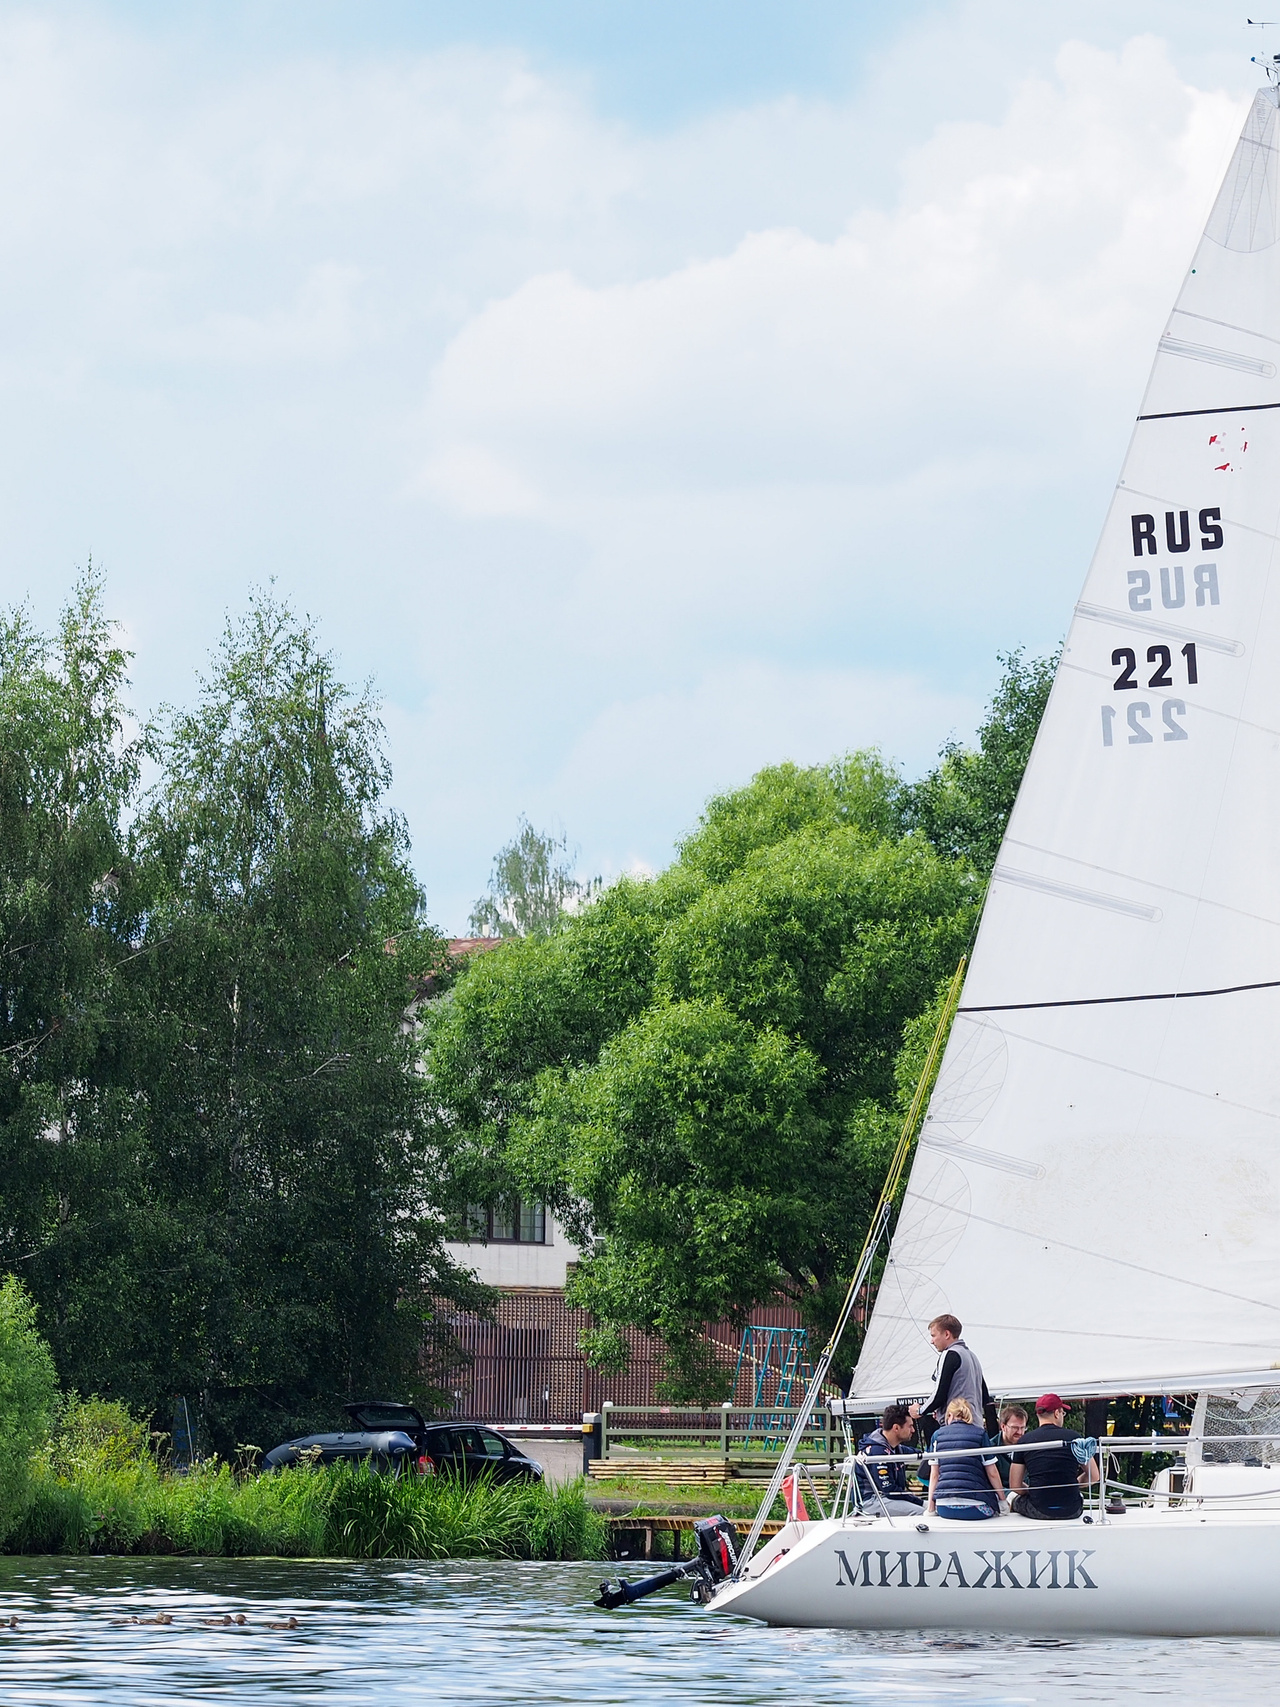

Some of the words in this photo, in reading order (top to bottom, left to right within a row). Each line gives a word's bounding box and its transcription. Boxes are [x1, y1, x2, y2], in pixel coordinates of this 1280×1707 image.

[1130, 506, 1225, 557] RUS
[1111, 643, 1198, 691] 221
[833, 1549, 1099, 1590] МИРАЖИК
